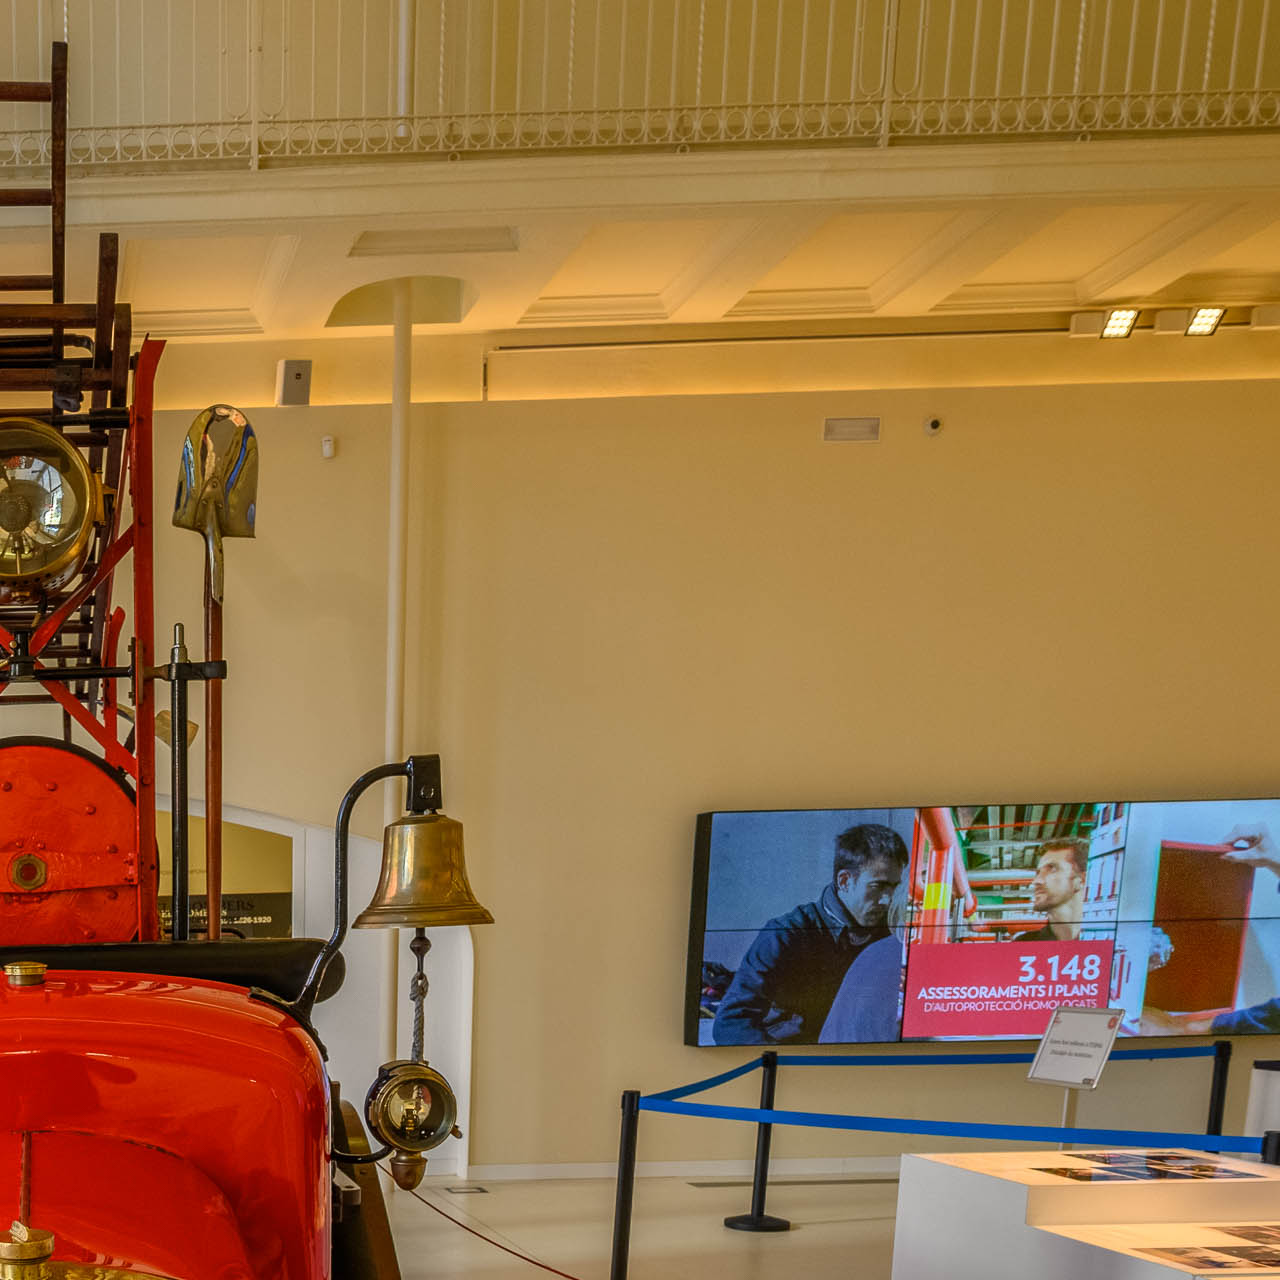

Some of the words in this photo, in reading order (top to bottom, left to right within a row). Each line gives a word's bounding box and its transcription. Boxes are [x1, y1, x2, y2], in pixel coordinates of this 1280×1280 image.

[1018, 954, 1101, 982] 3.148
[918, 984, 1045, 1000] ASSESSORAMENTS
[1048, 985, 1053, 998] I
[1055, 983, 1099, 997] PLANS
[924, 999, 1023, 1012] D'AUTOPROTECCIÓ
